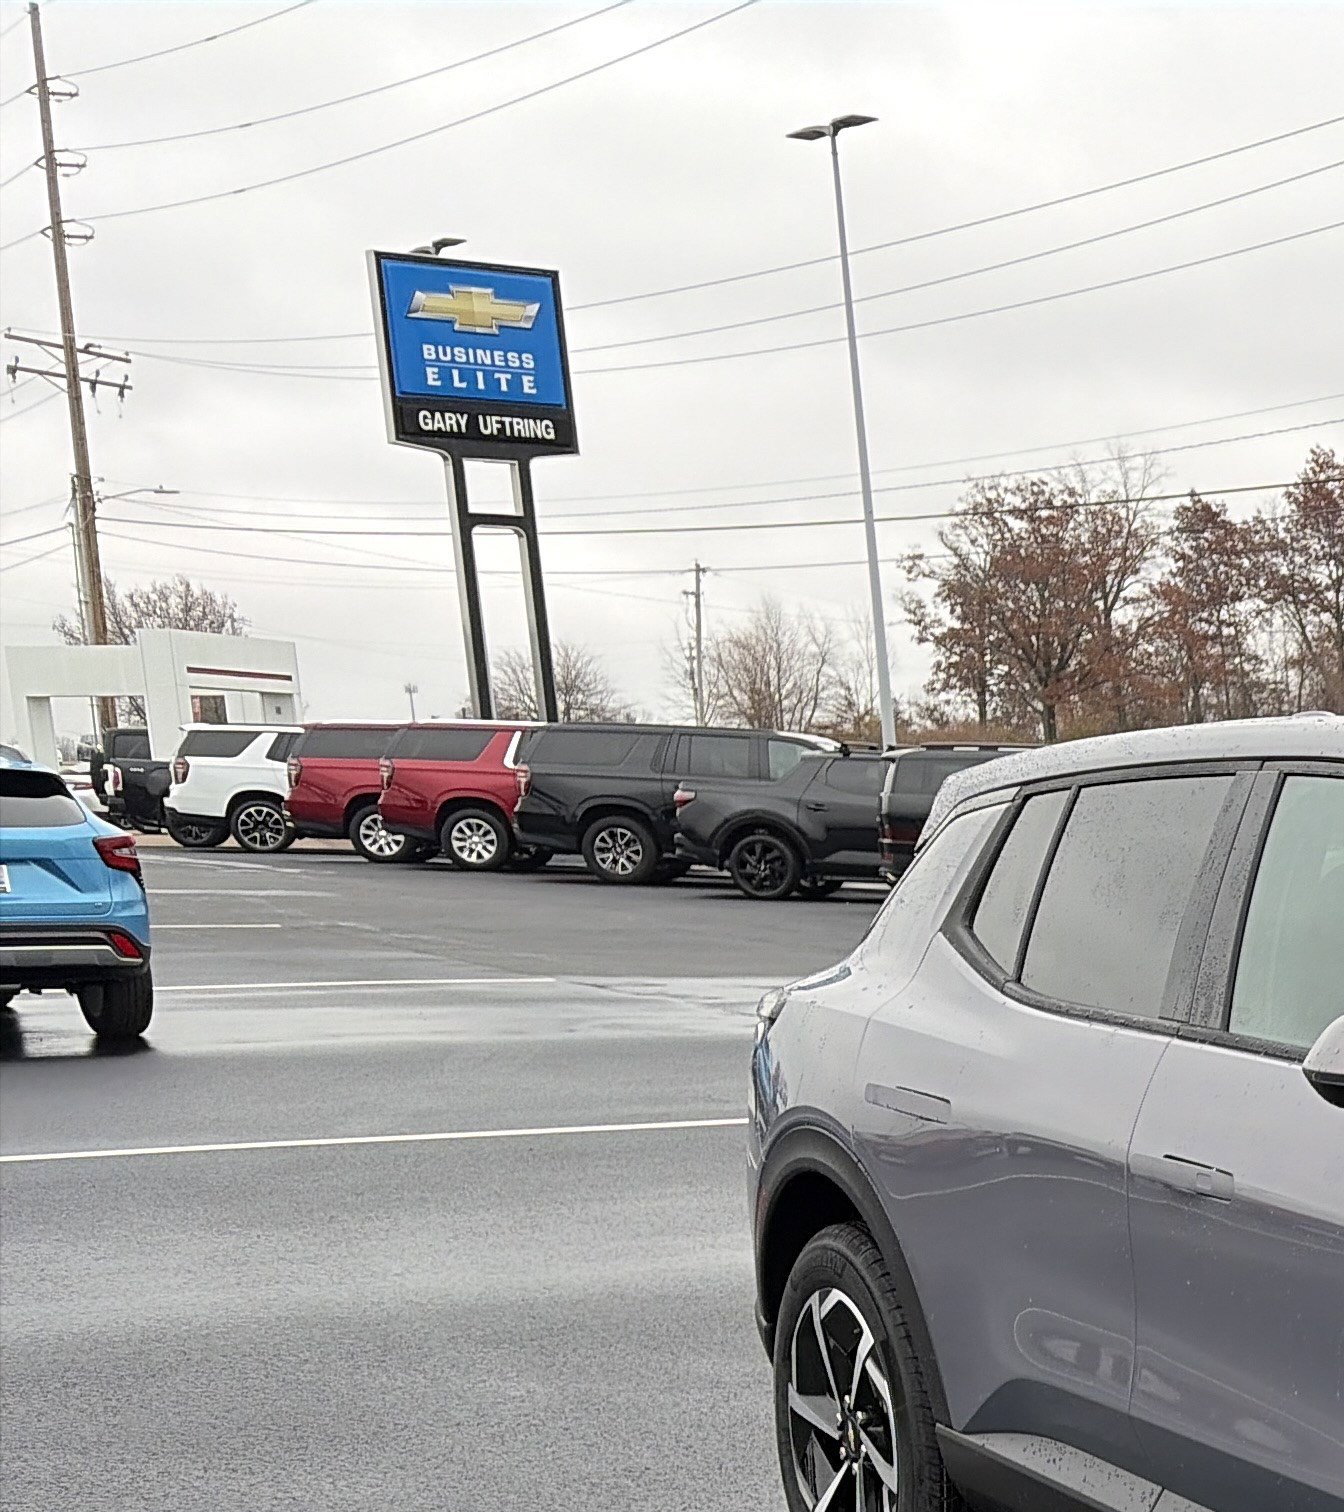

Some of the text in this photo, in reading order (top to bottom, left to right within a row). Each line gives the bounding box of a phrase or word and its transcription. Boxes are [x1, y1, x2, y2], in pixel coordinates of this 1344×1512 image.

[422, 344, 535, 368] BUSINESS
[425, 367, 538, 394] ELITE
[418, 410, 556, 440] GARY UFTRING
